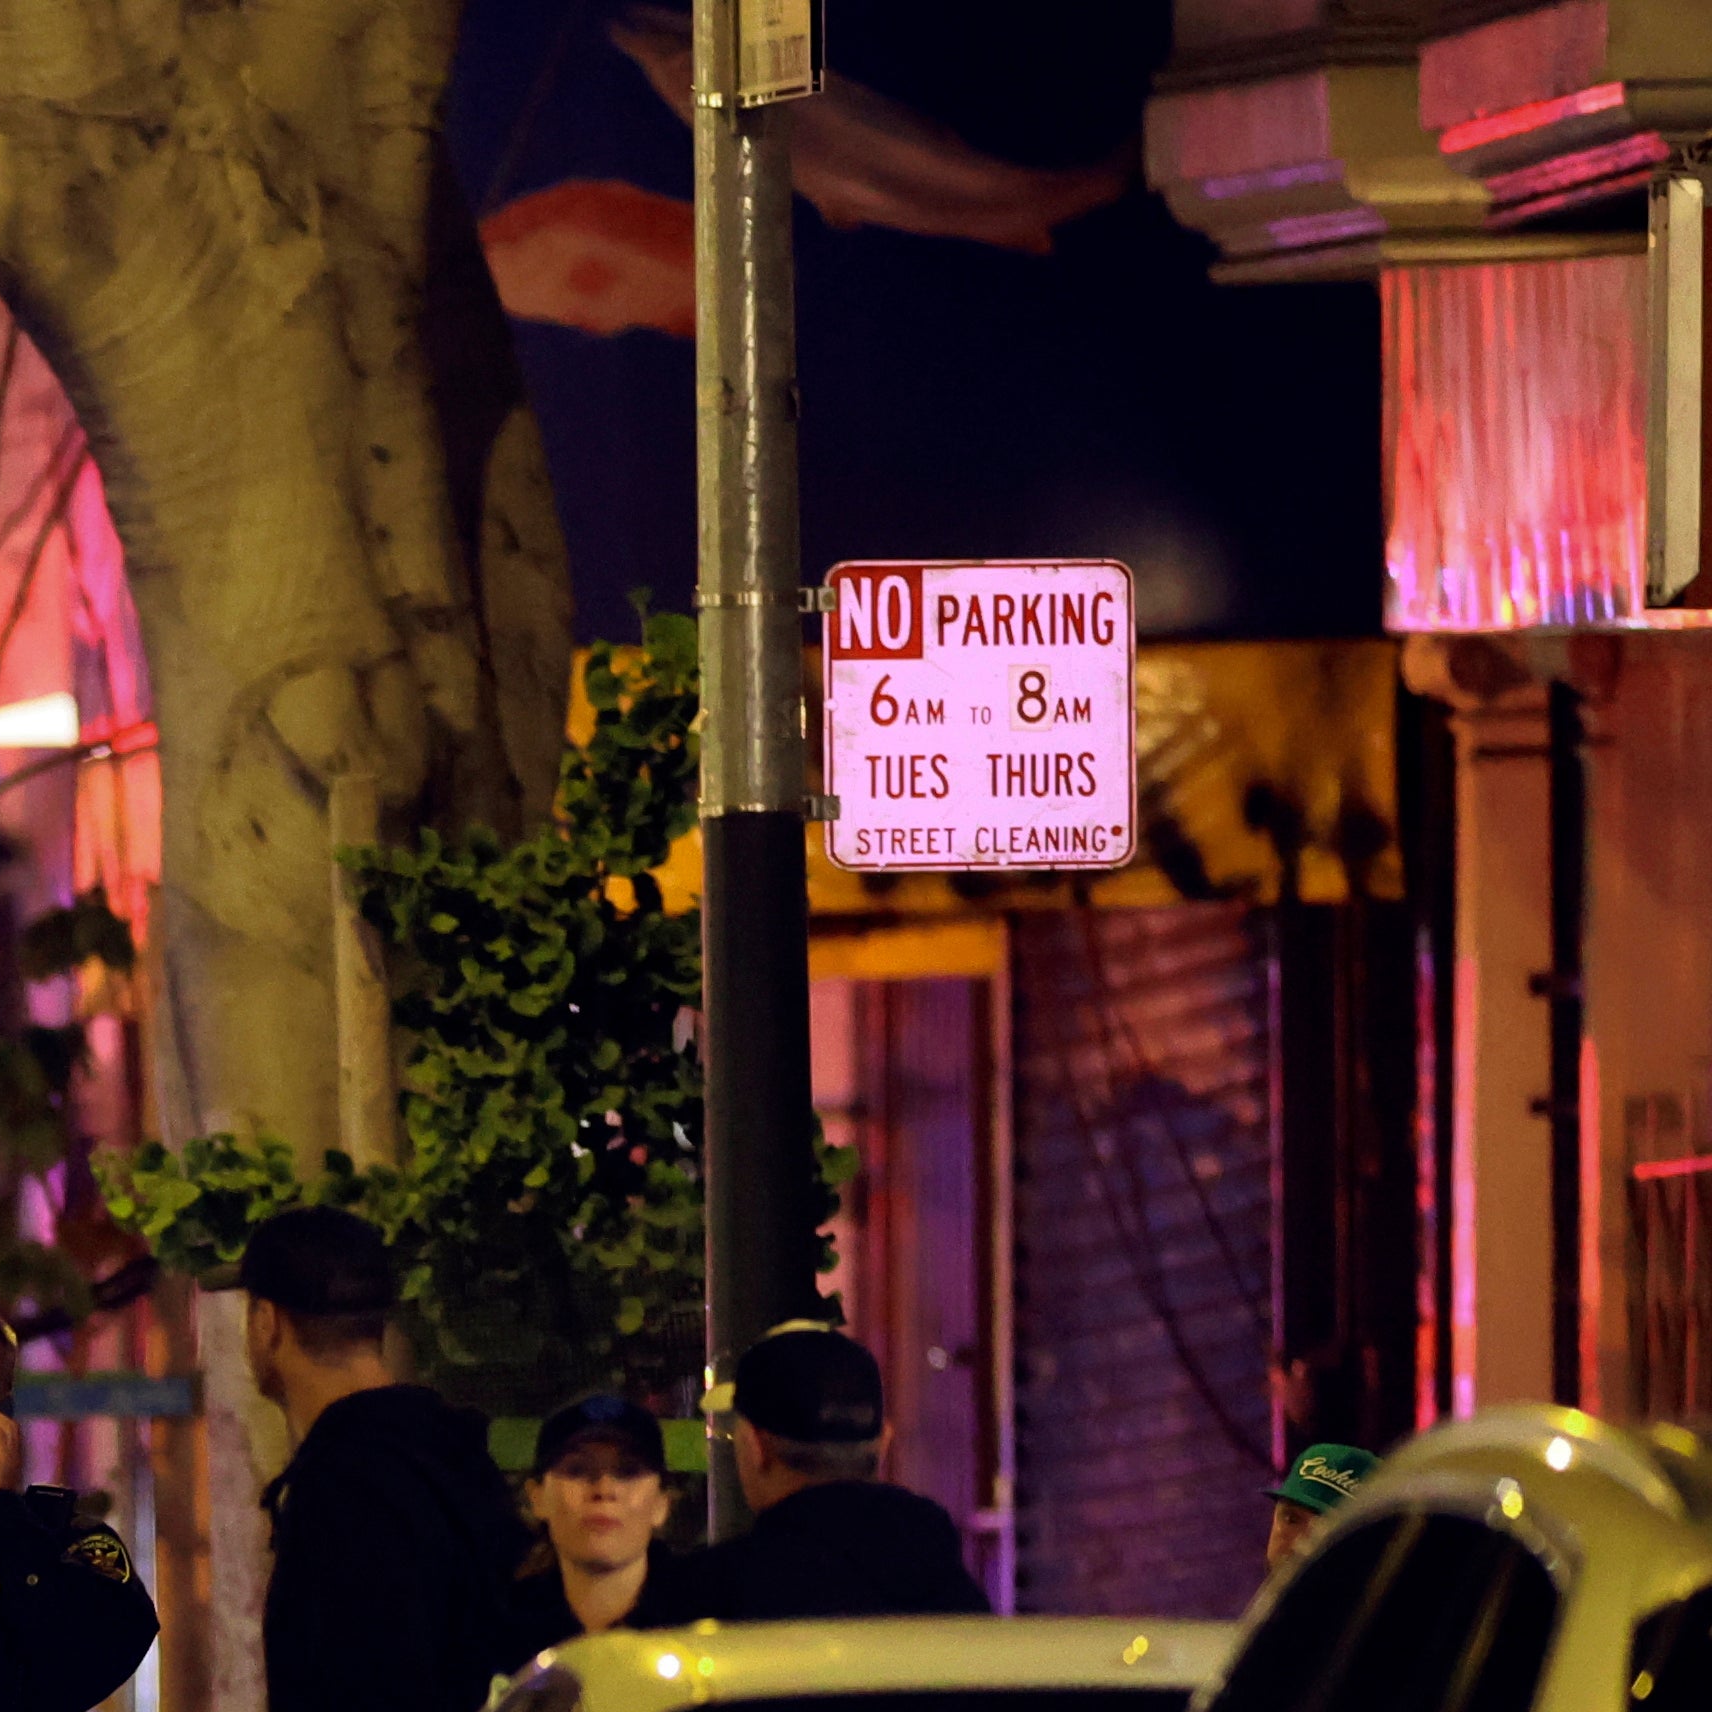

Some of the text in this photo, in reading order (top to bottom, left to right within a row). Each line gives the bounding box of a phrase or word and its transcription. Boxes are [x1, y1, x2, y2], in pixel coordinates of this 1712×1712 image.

[838, 574, 1114, 651] NO PARKING
[970, 705, 992, 725] TO
[864, 752, 1097, 799] TUES THURS
[855, 825, 1107, 855] STREET CLEANING
[1298, 1456, 1360, 1494] Cooki
